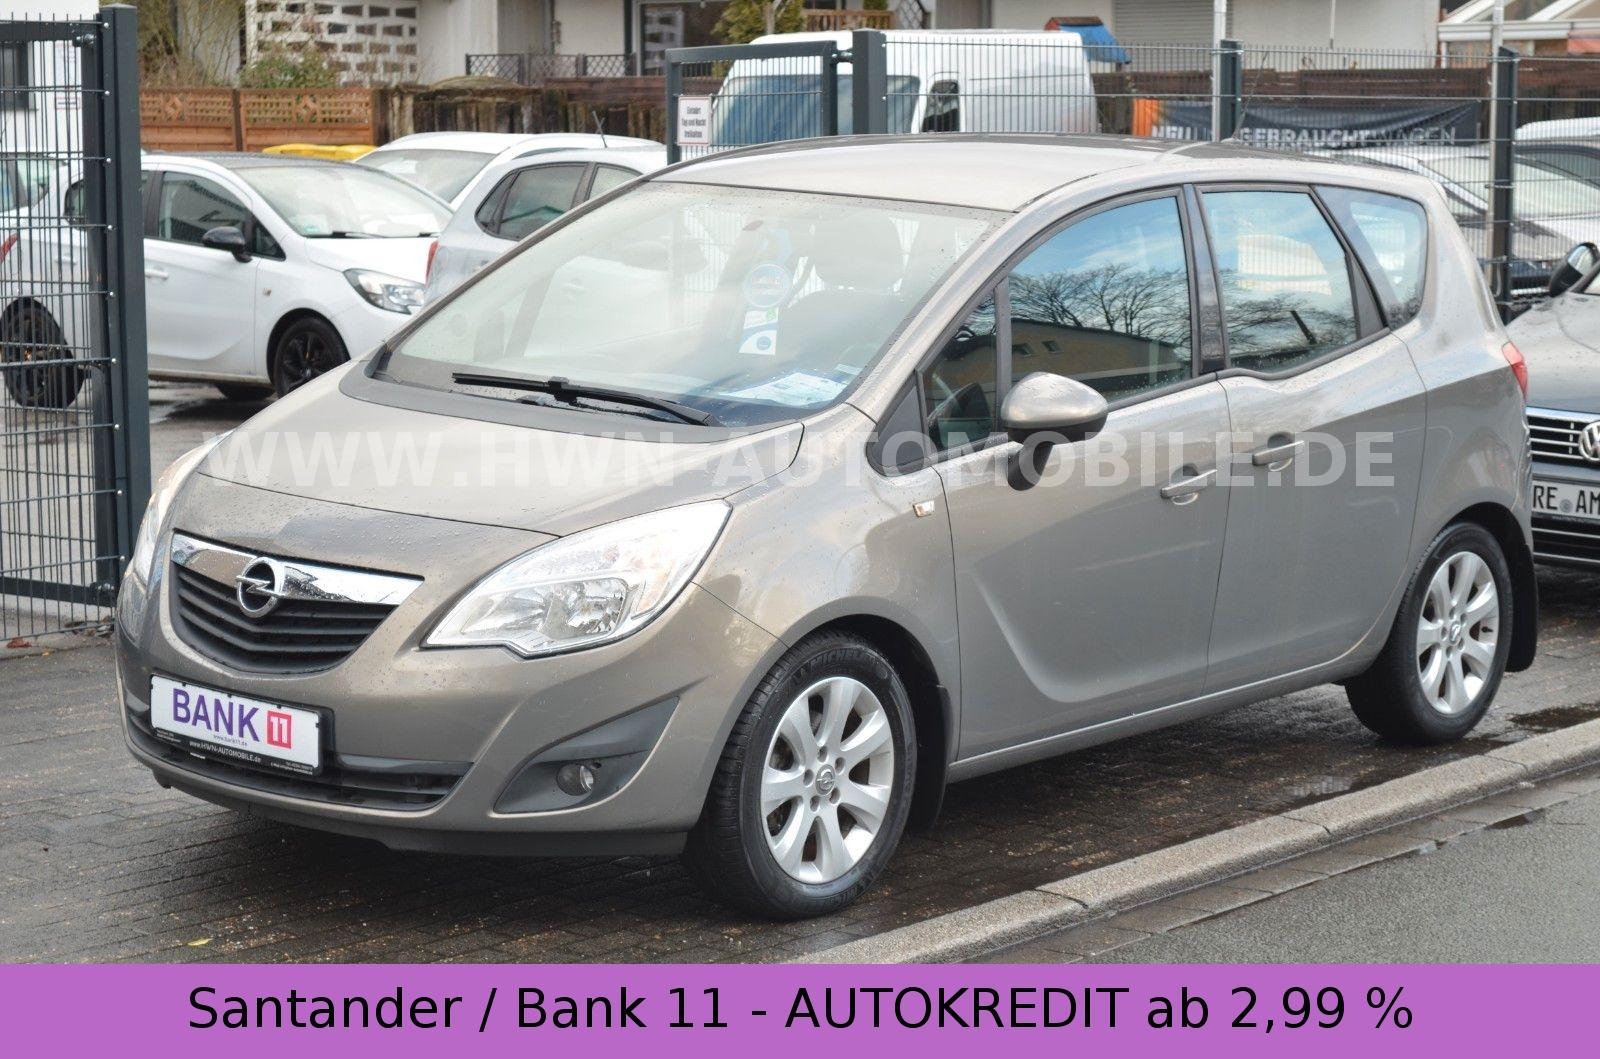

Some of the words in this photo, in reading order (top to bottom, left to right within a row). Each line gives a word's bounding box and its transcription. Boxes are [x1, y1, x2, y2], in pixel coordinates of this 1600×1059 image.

[1532, 485, 1558, 510] RE
[172, 687, 260, 743] BANK
[269, 714, 290, 746] 11
[188, 741, 262, 763] www.HWN-AUTOMOBILE.de
